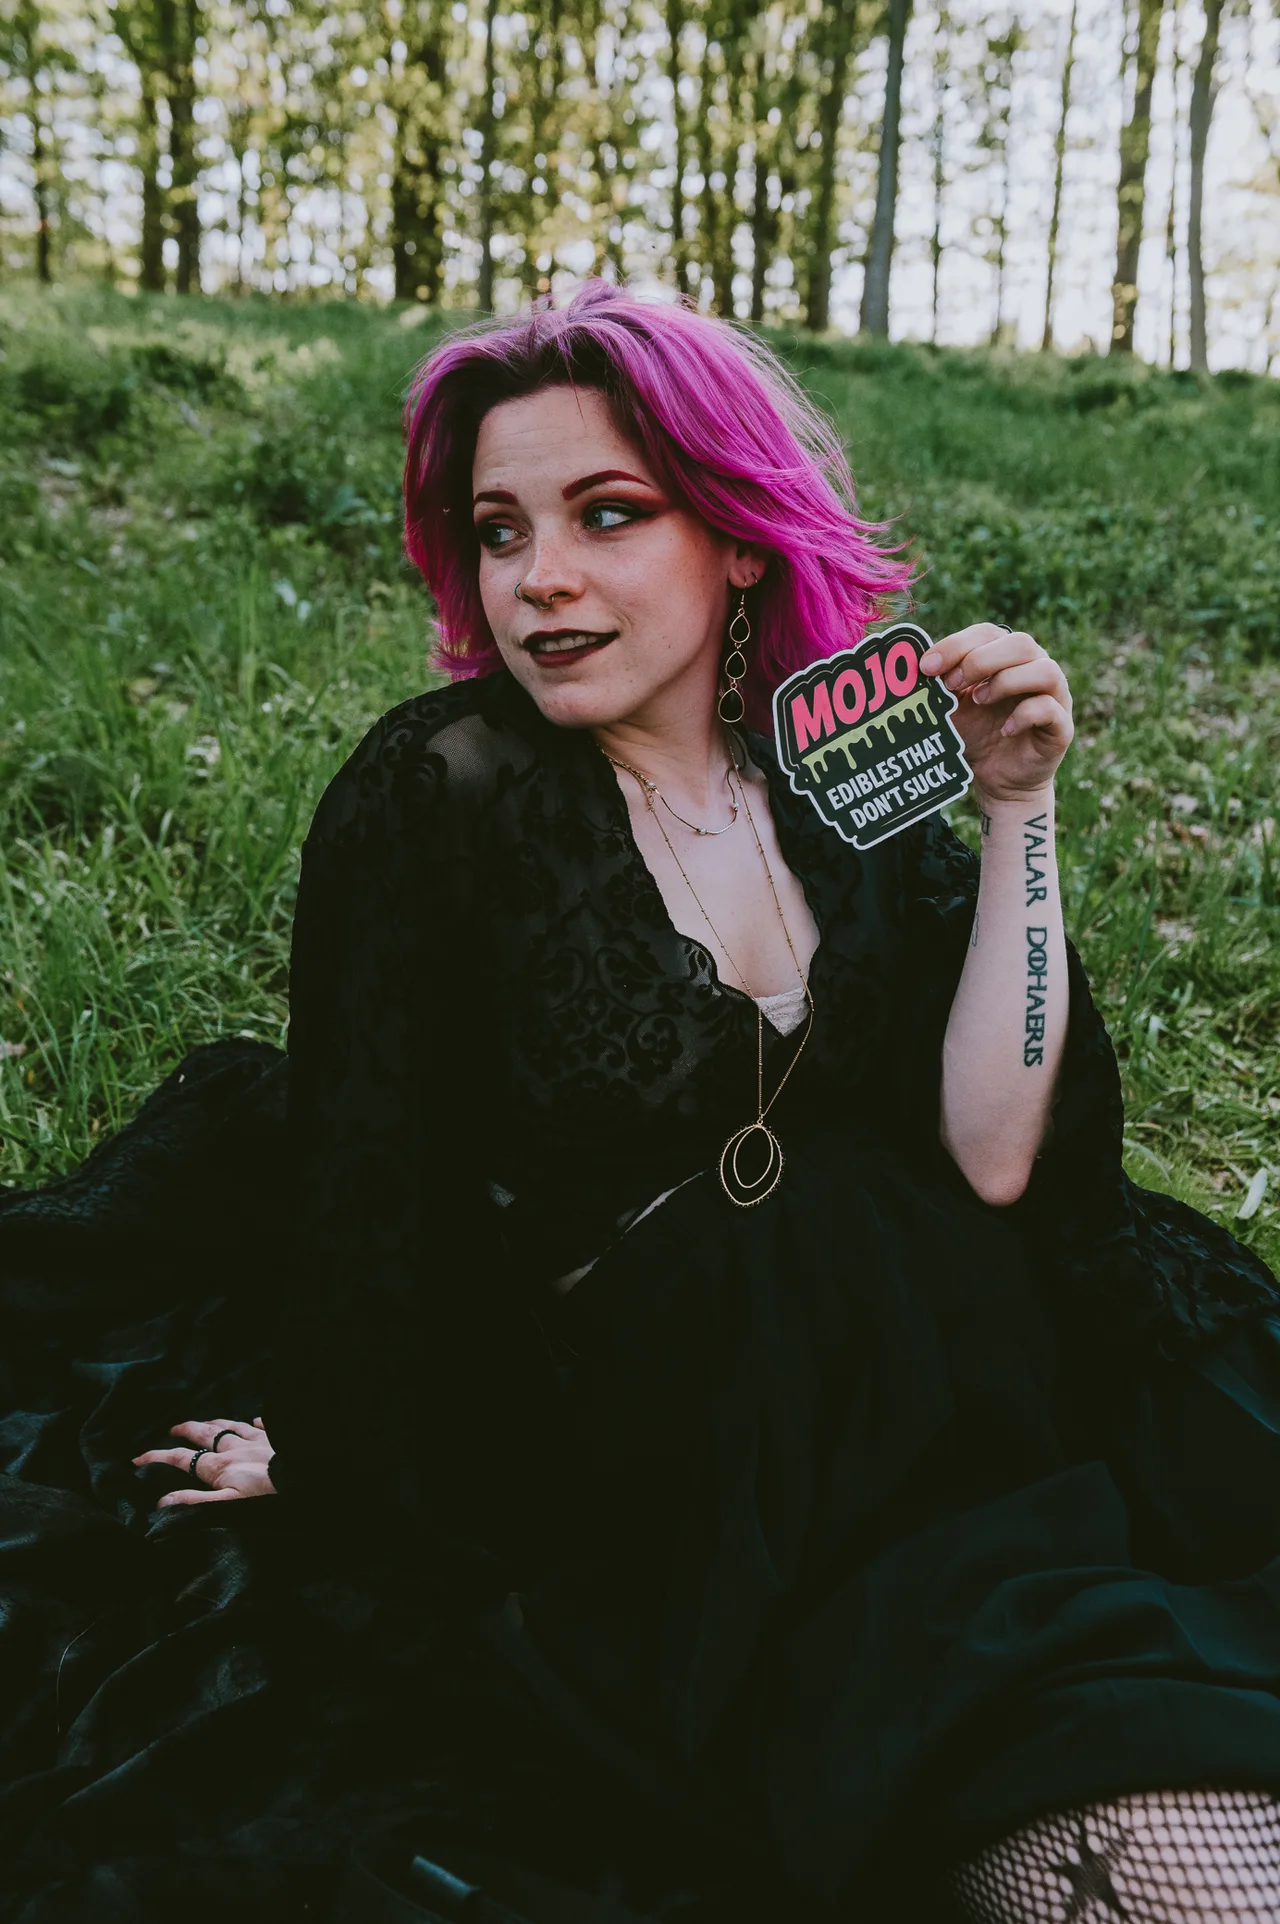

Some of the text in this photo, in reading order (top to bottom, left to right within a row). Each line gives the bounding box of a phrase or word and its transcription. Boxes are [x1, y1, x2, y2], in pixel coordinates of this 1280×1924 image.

[791, 641, 918, 753] MOJO
[826, 732, 946, 811] EDIBLES THAT
[850, 761, 957, 829] DON'T SUCK.
[1023, 813, 1048, 1067] VALAR DOHAERIS
